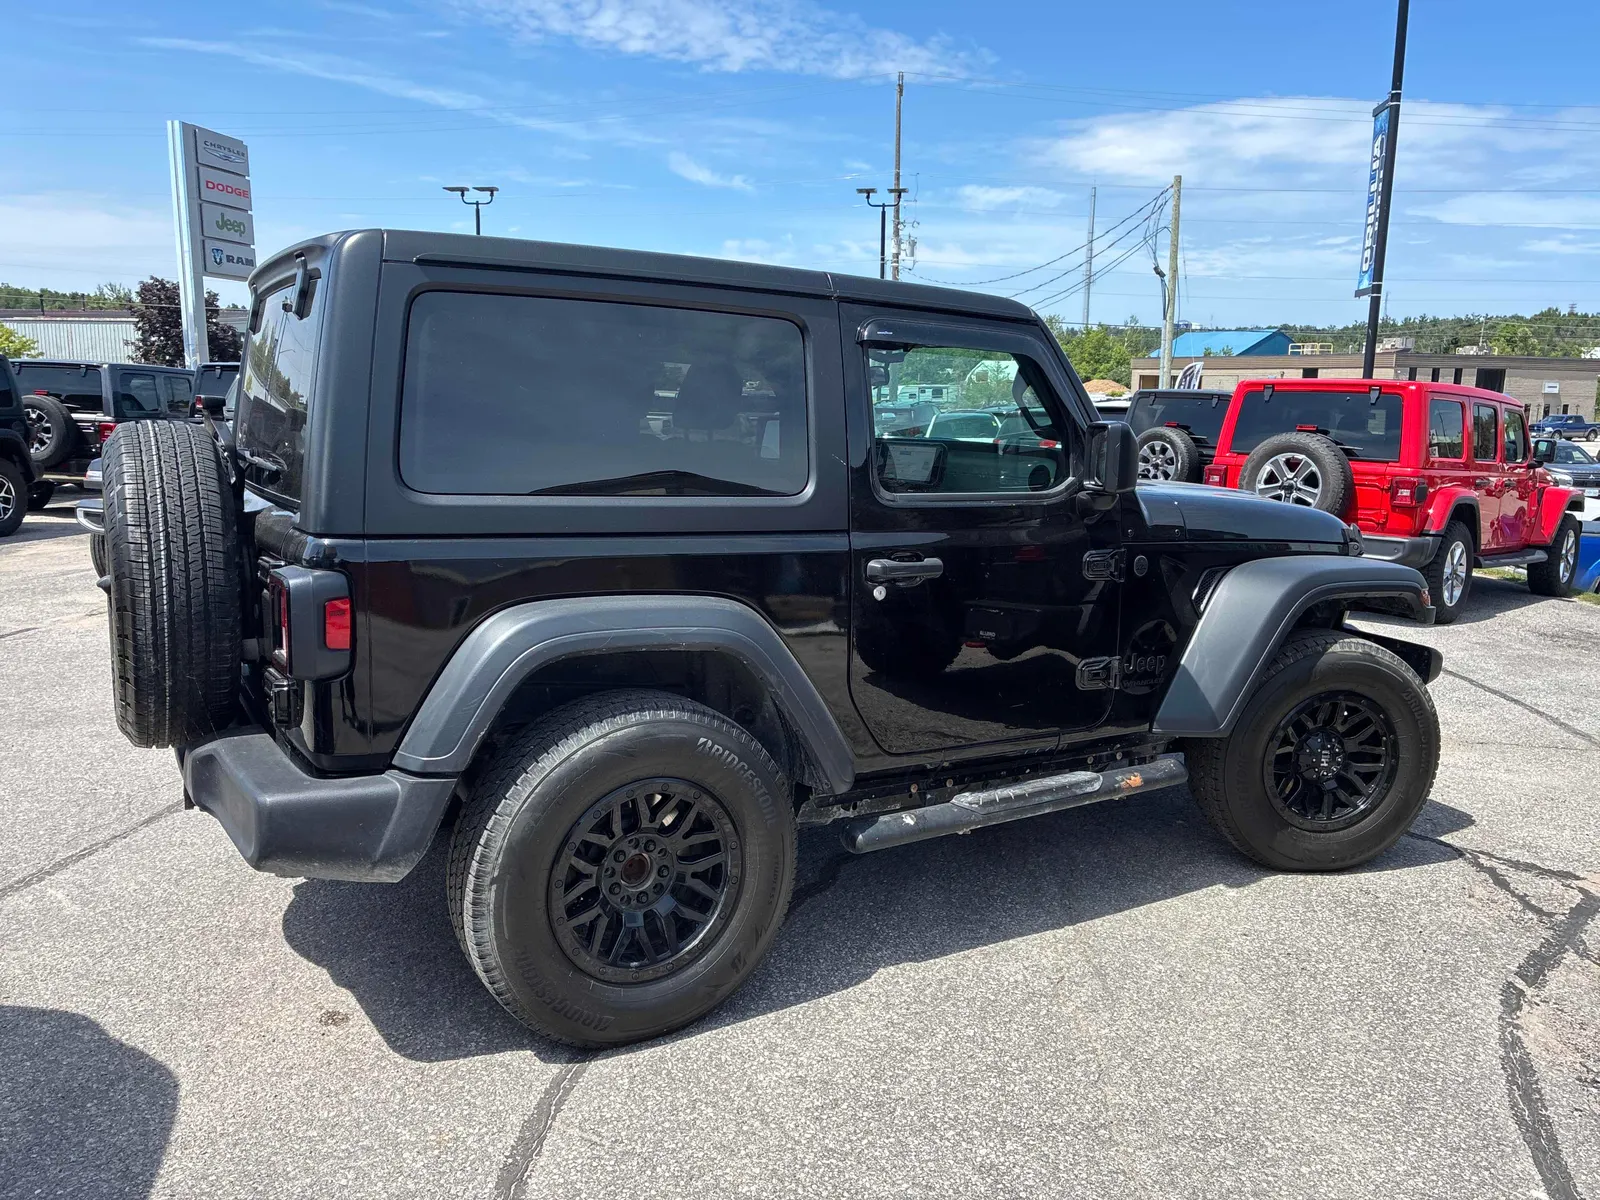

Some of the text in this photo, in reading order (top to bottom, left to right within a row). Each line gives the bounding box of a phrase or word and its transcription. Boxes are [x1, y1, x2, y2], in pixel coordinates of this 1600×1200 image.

[204, 140, 246, 157] CHRYSLER
[205, 180, 249, 198] DODGE
[1362, 136, 1381, 272] ORILLIA
[216, 212, 246, 237] Jeep
[225, 254, 254, 267] RAM
[1124, 652, 1167, 675] Jeep
